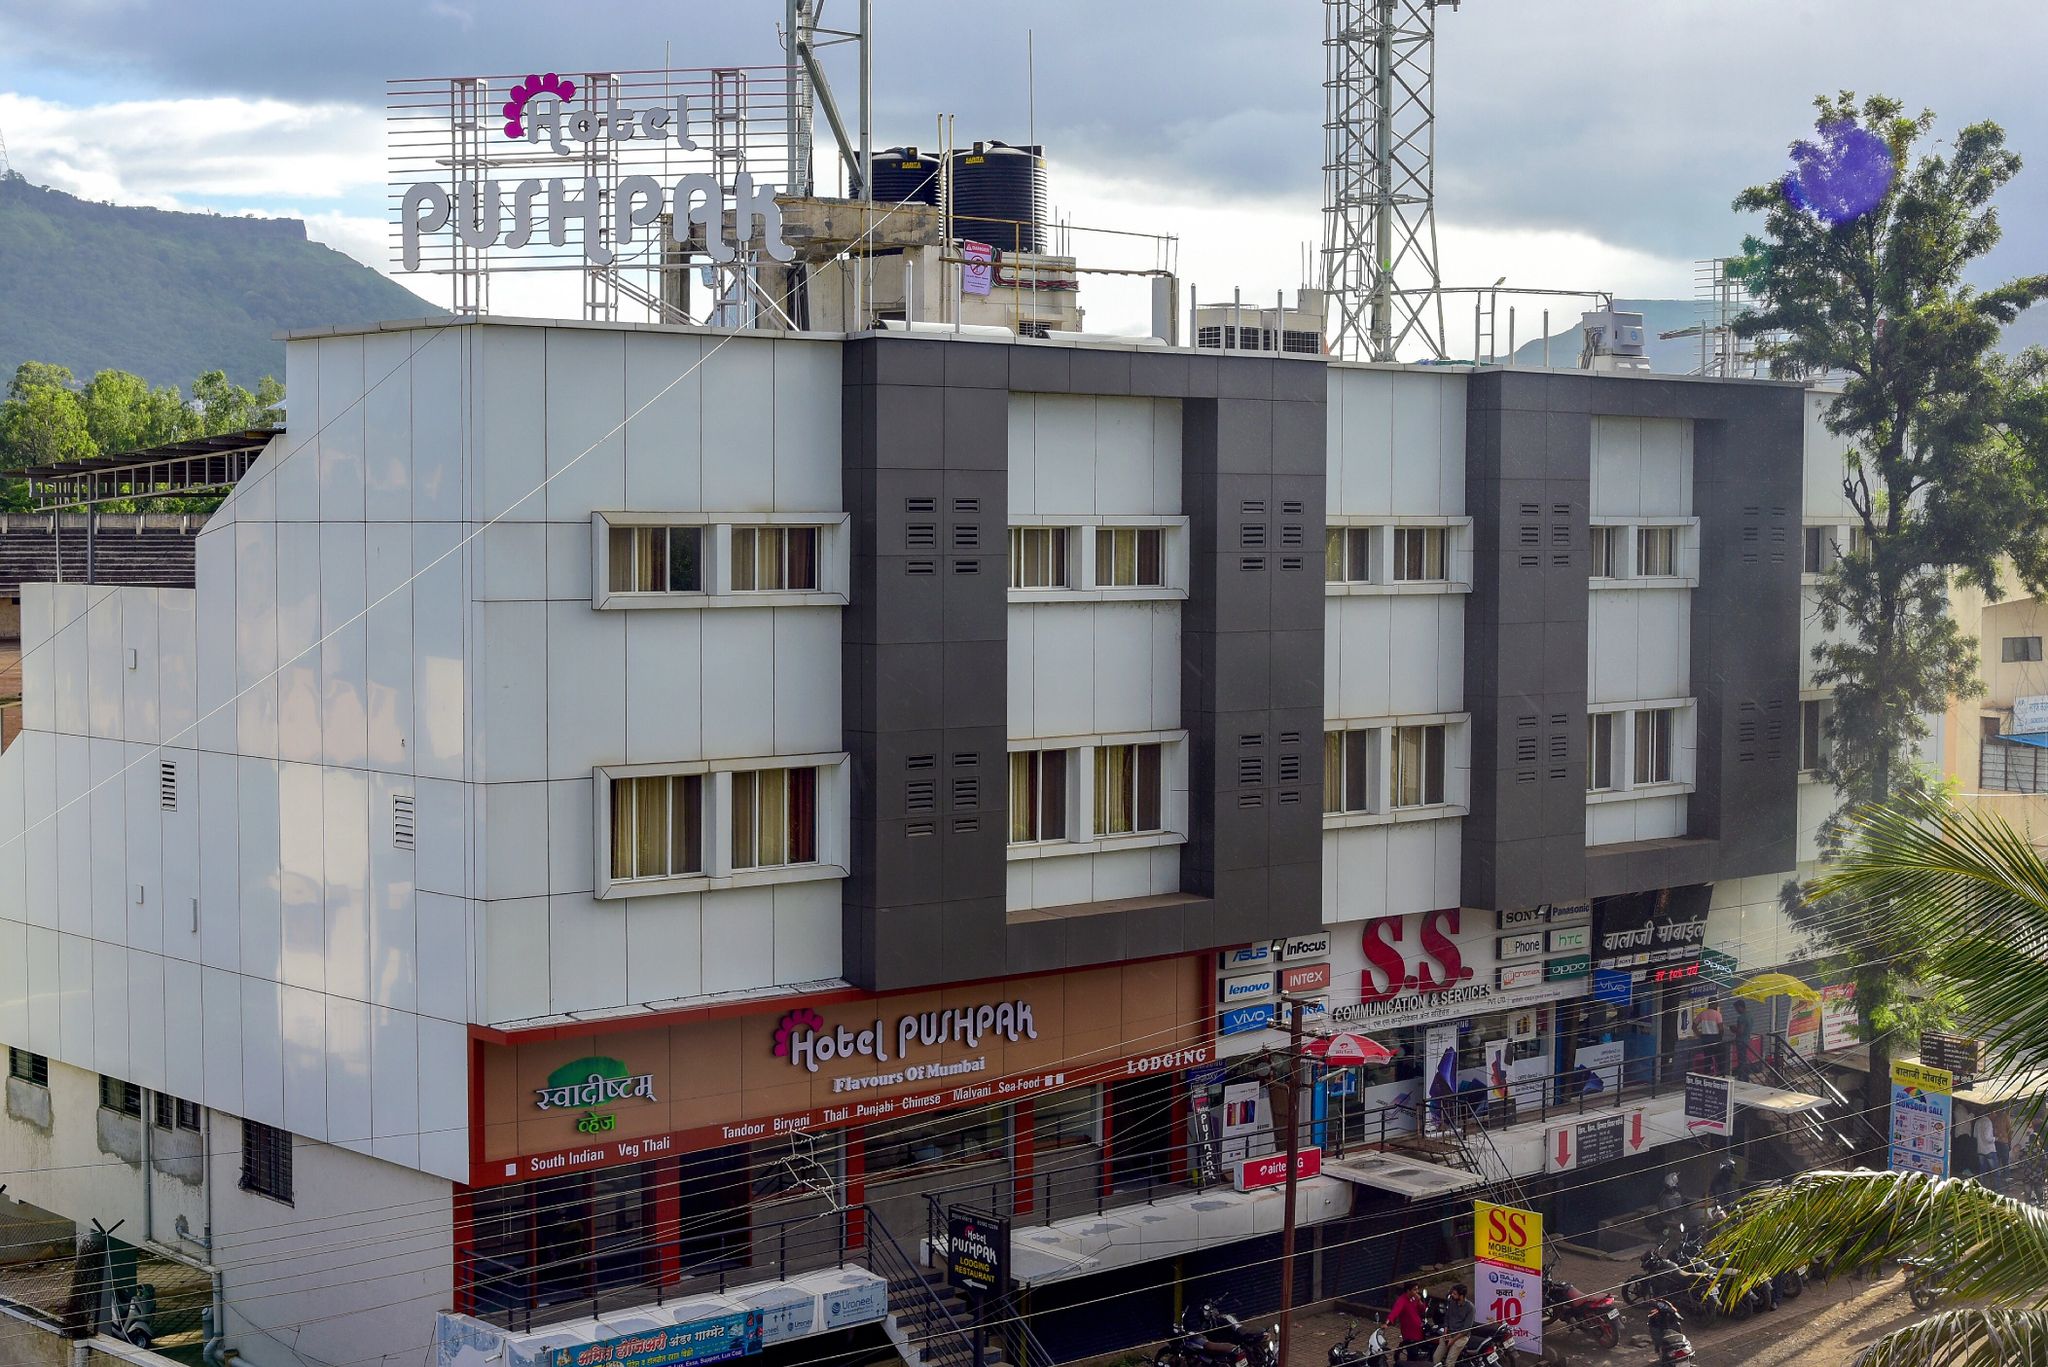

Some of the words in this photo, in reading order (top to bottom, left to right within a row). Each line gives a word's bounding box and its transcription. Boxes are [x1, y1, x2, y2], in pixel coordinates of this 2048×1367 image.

[527, 94, 697, 156] Hotel
[402, 172, 796, 272] PUSHPAK
[1553, 904, 1589, 916] Panasonic
[1604, 920, 1655, 951] बालाजी
[1657, 914, 1707, 942] मोबाईल
[1232, 946, 1268, 962] ASUS
[1287, 941, 1327, 955] InFocus
[1229, 982, 1270, 995] lenovo
[1600, 981, 1626, 993] vivo
[1335, 996, 1427, 1023] COMMUNICATION
[1430, 992, 1440, 1006] &
[1441, 984, 1491, 1005] SERVICES
[1233, 1010, 1266, 1025] vivo
[790, 1018, 888, 1073] Hotel
[898, 1000, 1038, 1059] PUSHPAK
[1127, 1048, 1207, 1074] LODGING
[833, 1067, 904, 1093] Flavours
[907, 1063, 925, 1081] Of
[928, 1056, 986, 1080] Mumbai
[577, 1111, 616, 1134] व्हेज
[722, 1121, 765, 1139] Tandoor
[773, 1112, 810, 1132] Biryani
[823, 1105, 849, 1122] Thali
[856, 1099, 894, 1117] Punjabi
[902, 1093, 941, 1110] Chinese
[953, 1084, 992, 1101] Malvani
[531, 1153, 566, 1171] South
[569, 1147, 604, 1166] Indian
[618, 1142, 639, 1158] Veg
[642, 1136, 670, 1153] Thali
[1268, 1162, 1287, 1175] airte
[1297, 1157, 1304, 1168] G
[968, 1230, 987, 1245] Hotel
[1488, 1207, 1527, 1248] SS
[952, 1237, 998, 1265] PUSHPAK
[1488, 1242, 1526, 1258] MOBILES
[954, 1264, 995, 1283] RESTAURANT
[959, 1257, 990, 1272] LODGING
[1500, 1274, 1524, 1284] BAJAJ
[842, 1295, 873, 1310] Uroneel
[1490, 1297, 1522, 1326] 10
[669, 1332, 692, 1347] अंडर
[695, 1325, 725, 1341] गारमेंट
